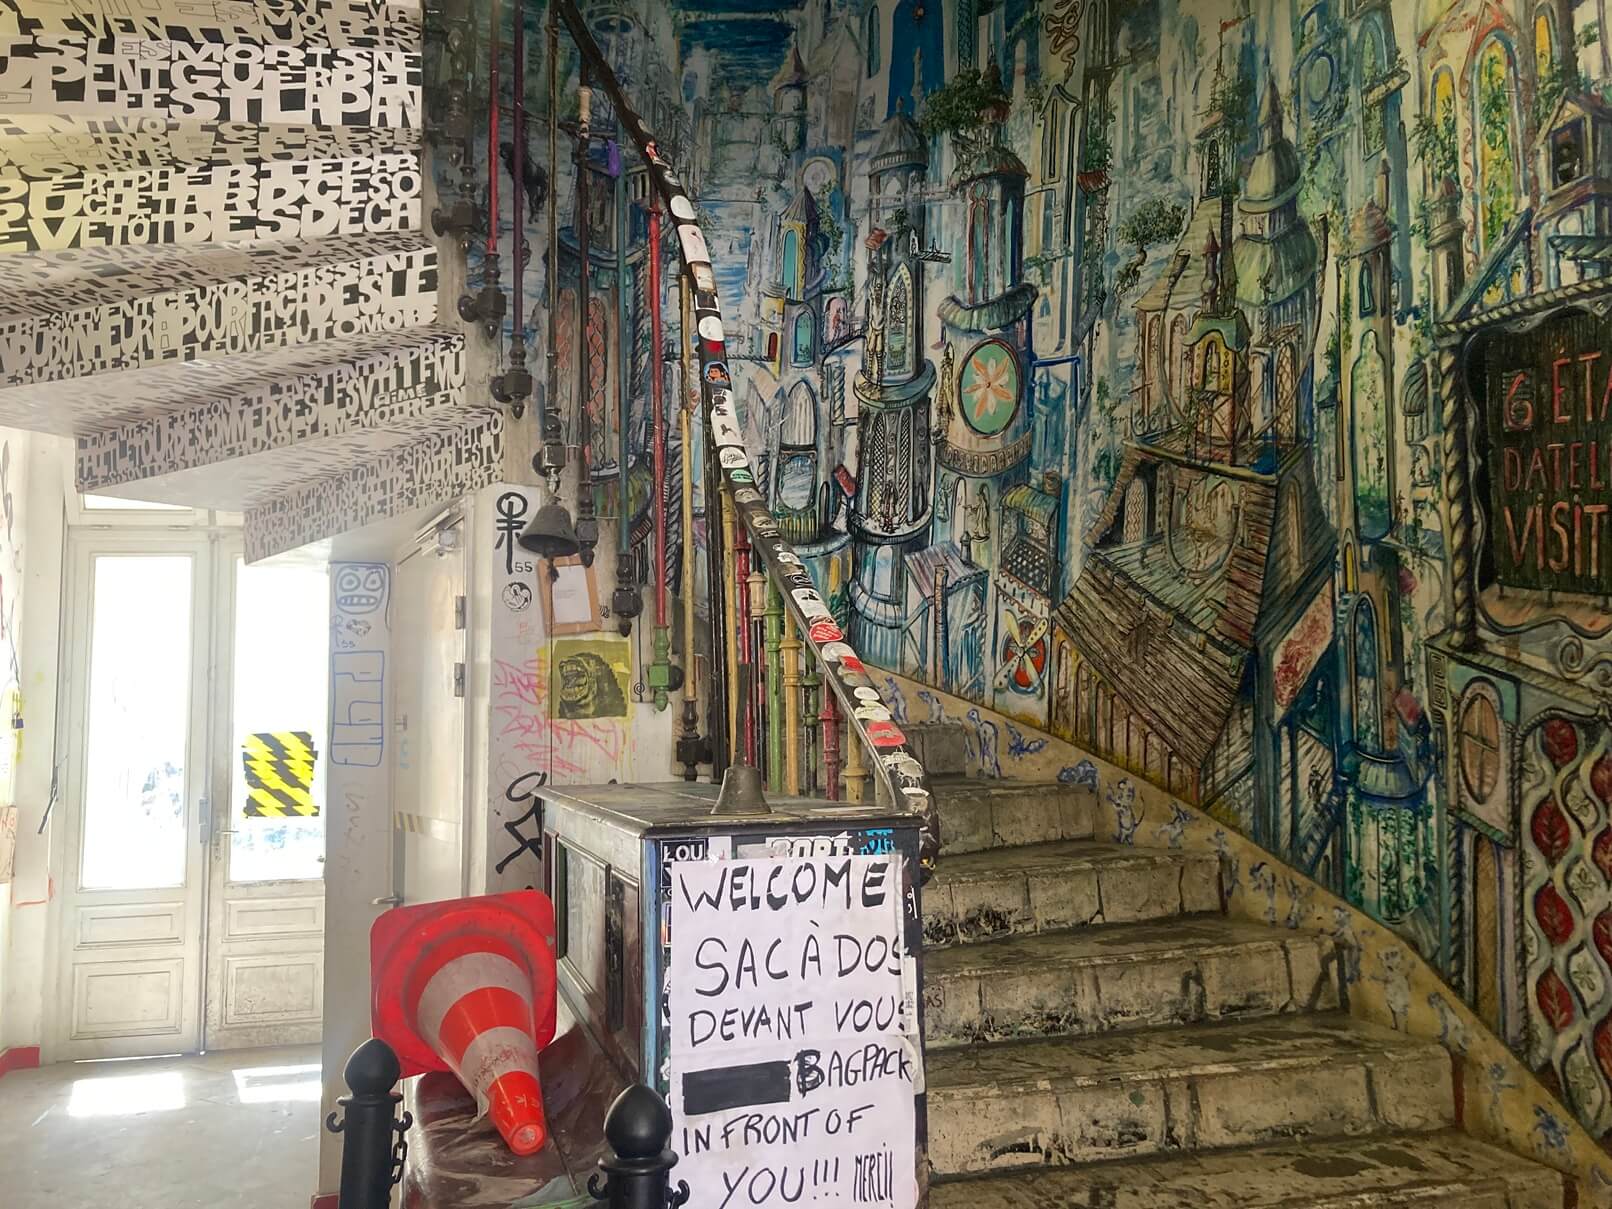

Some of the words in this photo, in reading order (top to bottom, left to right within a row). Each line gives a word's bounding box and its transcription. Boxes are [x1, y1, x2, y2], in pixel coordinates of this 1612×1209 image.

[1503, 372, 1534, 430] 6
[1503, 441, 1612, 492] DATEL
[679, 860, 889, 913] WELCOME
[694, 936, 790, 997] SAC
[833, 932, 902, 978] DOS
[688, 1000, 814, 1049] DEVANT
[796, 1043, 913, 1099] BAGPACK
[682, 1125, 711, 1157] IN
[719, 1107, 821, 1150] FRONT
[824, 1103, 876, 1135] OF
